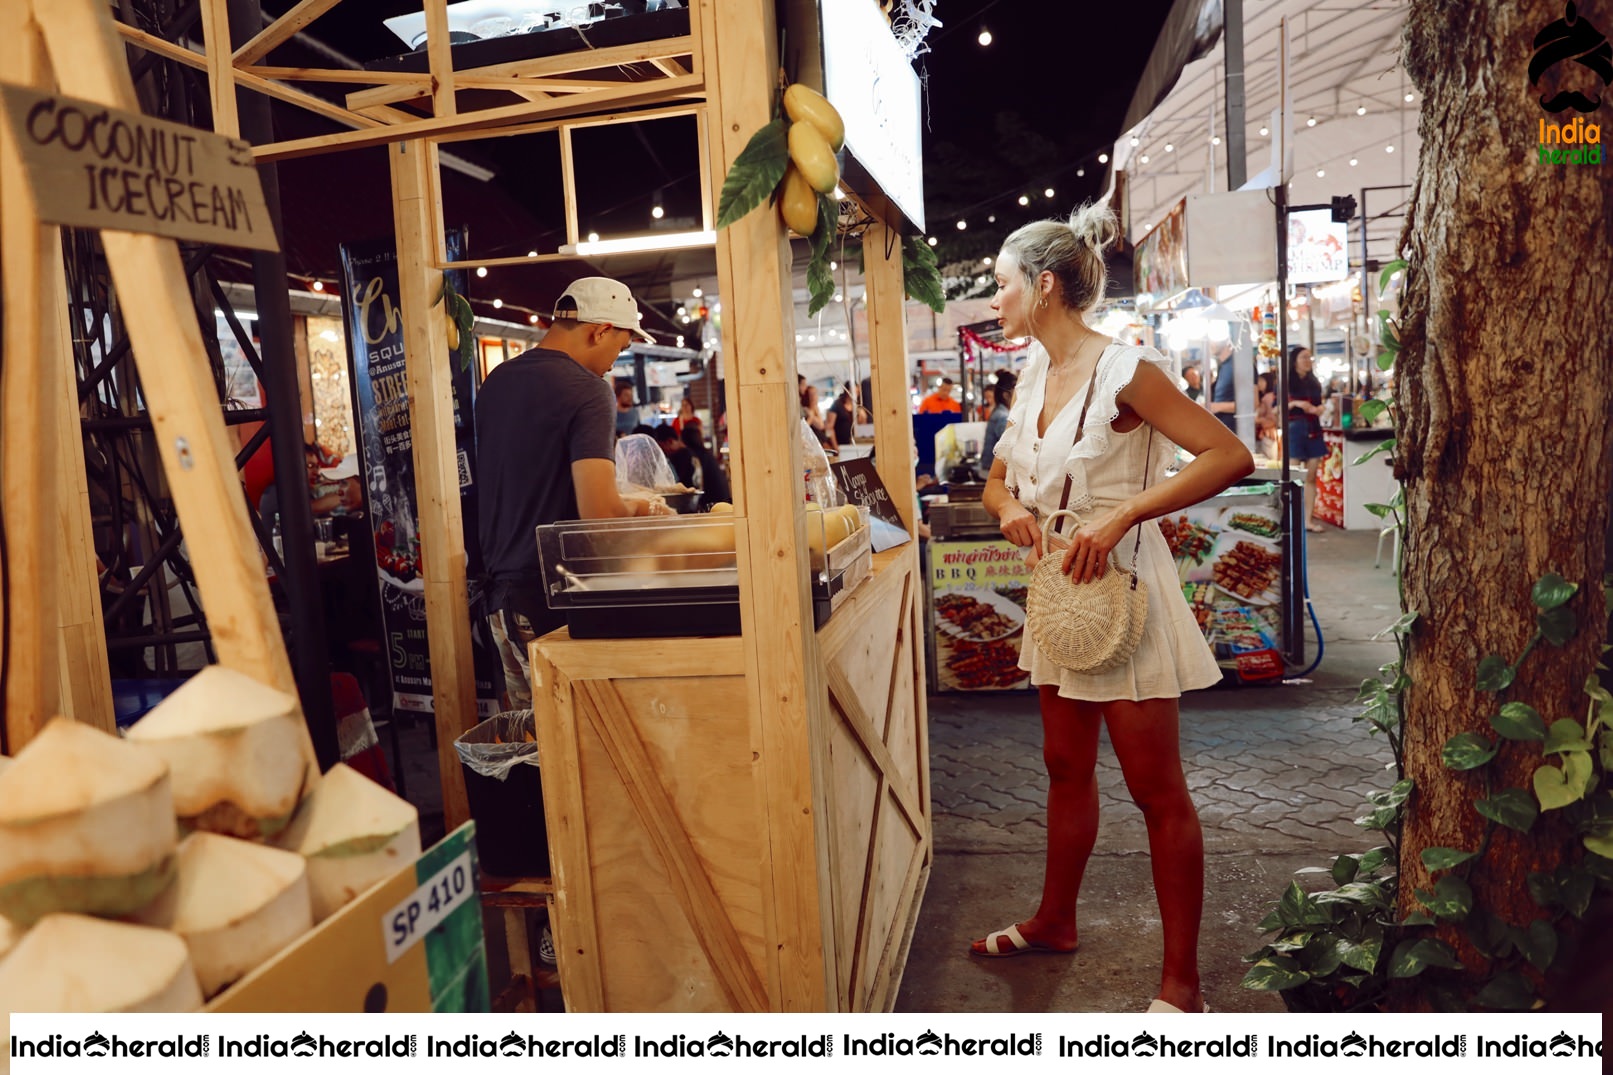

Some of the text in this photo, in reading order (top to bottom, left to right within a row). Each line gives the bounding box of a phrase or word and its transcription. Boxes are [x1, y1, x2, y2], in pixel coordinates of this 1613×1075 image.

[27, 97, 196, 176] COCONUT
[84, 163, 253, 233] ICECREAM
[391, 632, 407, 668] 5
[392, 865, 465, 946] SP 410
